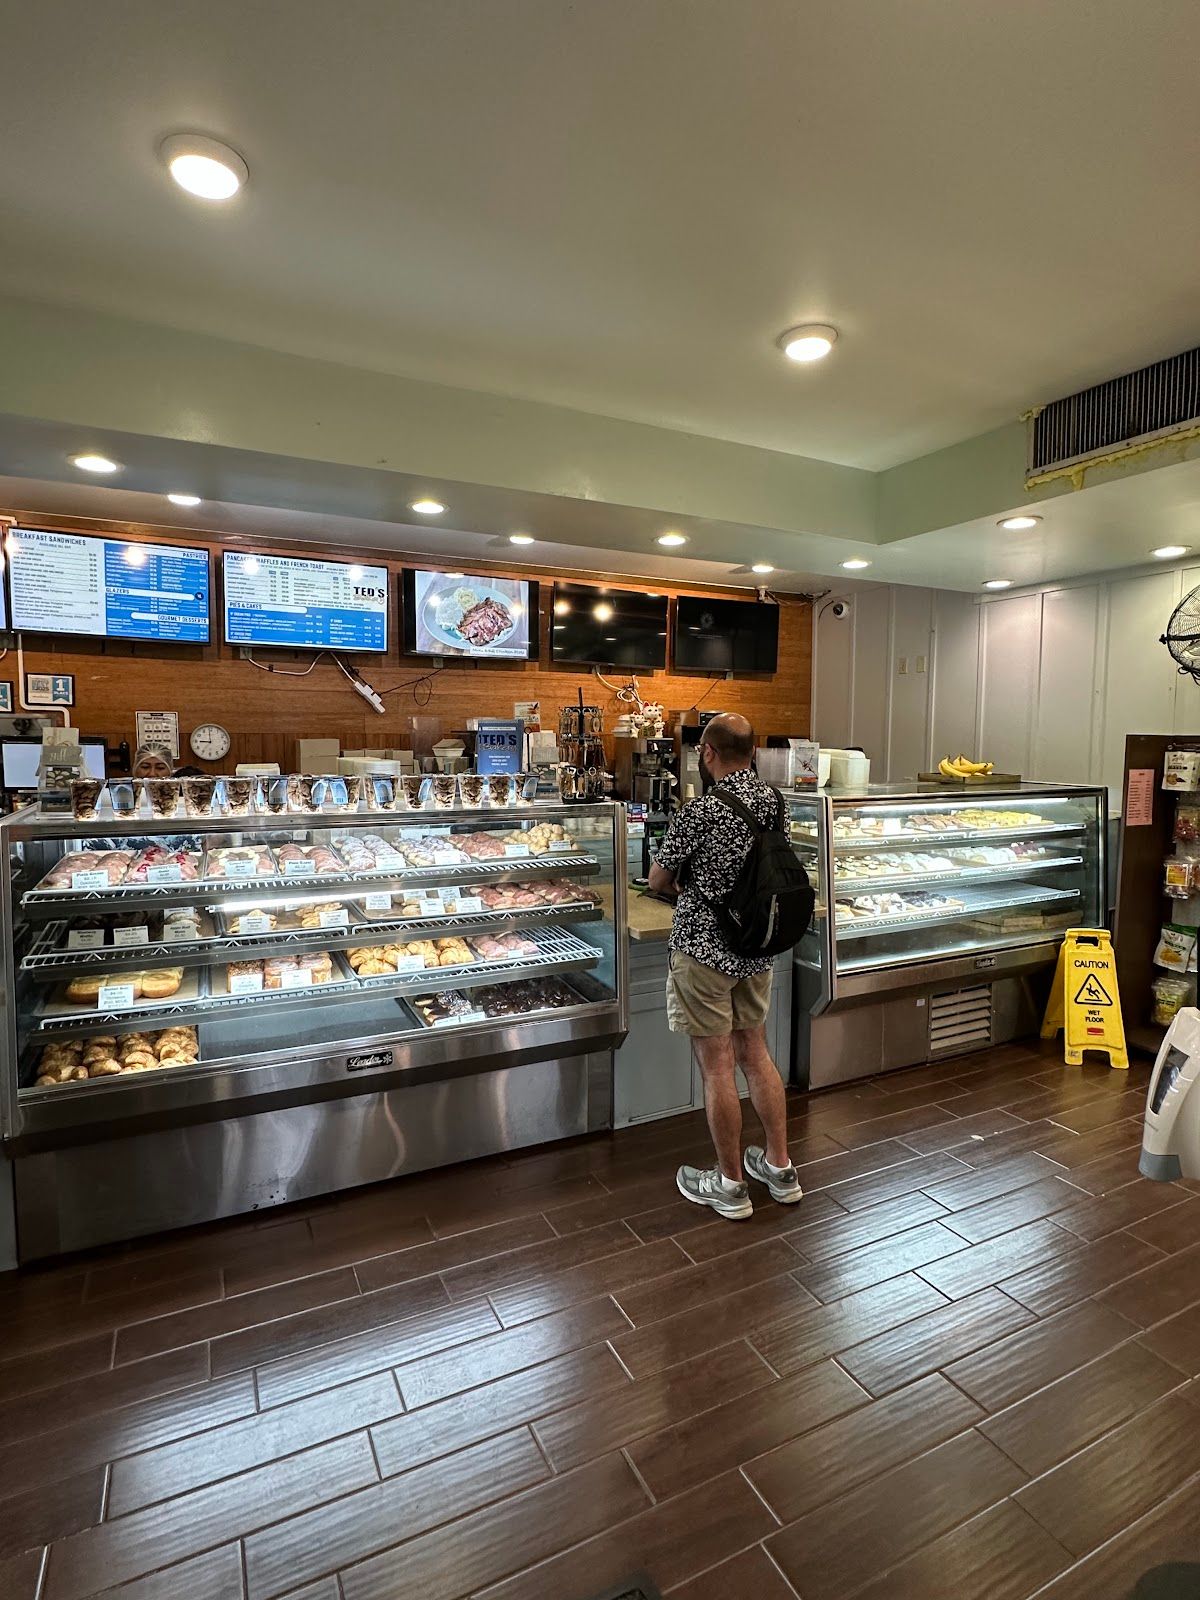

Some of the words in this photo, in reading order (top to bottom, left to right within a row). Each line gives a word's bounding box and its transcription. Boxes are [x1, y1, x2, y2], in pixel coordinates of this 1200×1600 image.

[12, 531, 48, 542] BREAKFAST
[48, 535, 87, 546] SANDWICHES
[182, 552, 207, 560] PASTRIES
[279, 560, 290, 568] AND
[290, 561, 309, 569] FRENCH
[309, 563, 324, 571] TOAST
[105, 587, 130, 595] GLAZERS
[353, 586, 385, 598] TED'S
[157, 614, 181, 622] GOURMET
[181, 616, 207, 624] DESSERTS
[482, 732, 517, 746] TED'S
[1074, 959, 1109, 969] CAUTION
